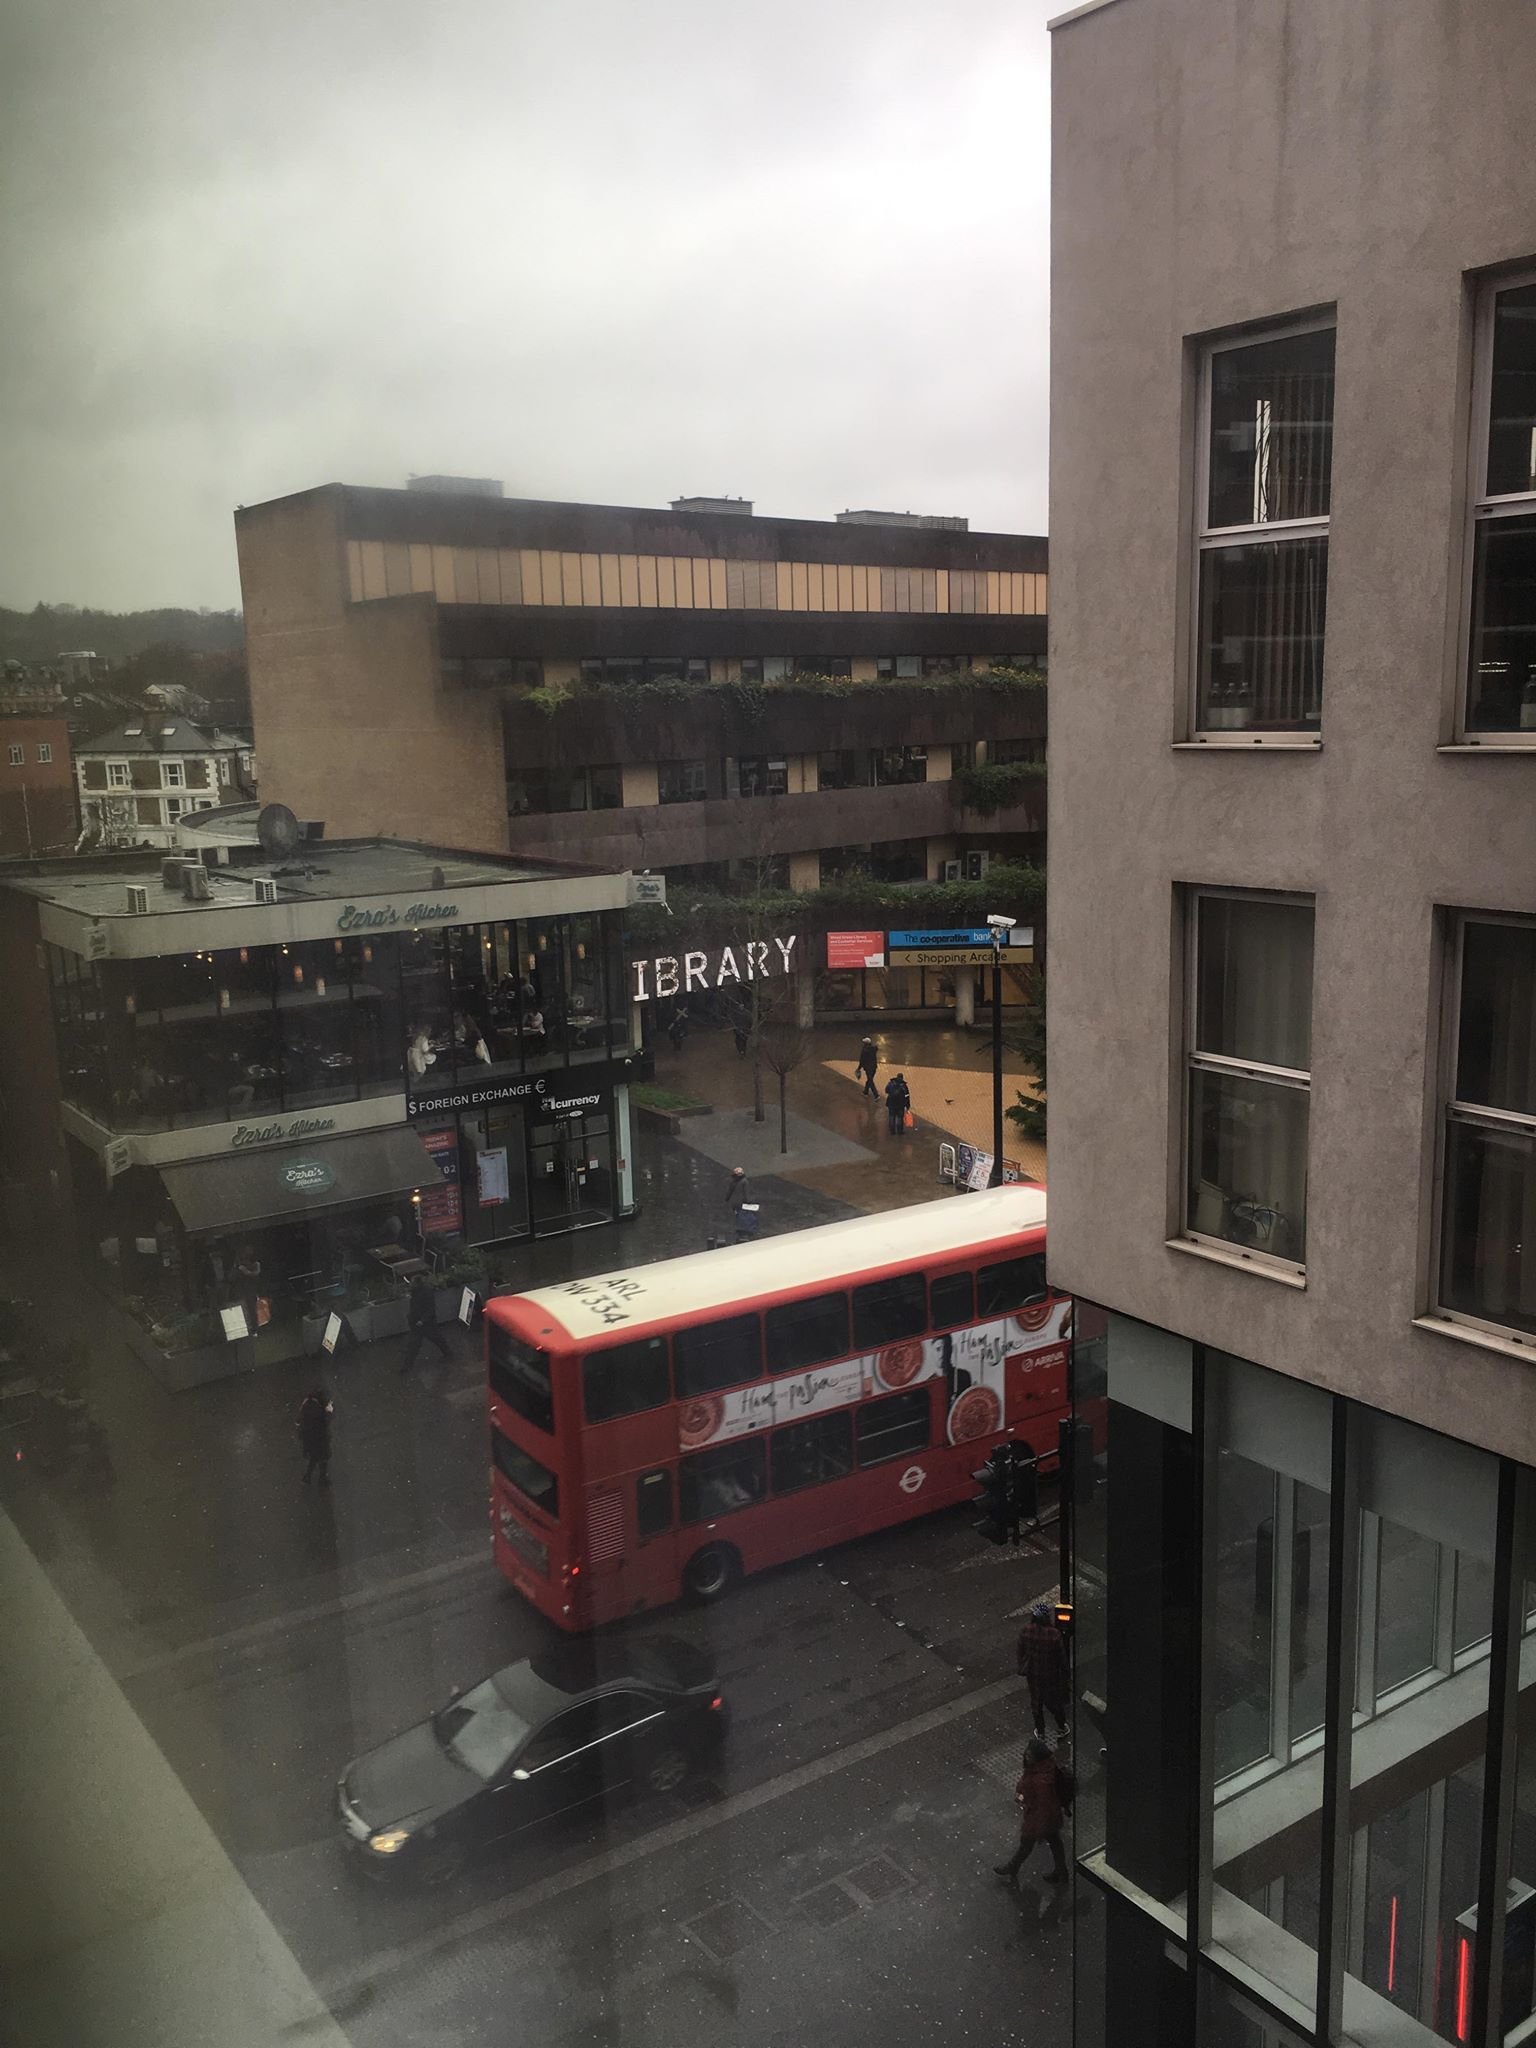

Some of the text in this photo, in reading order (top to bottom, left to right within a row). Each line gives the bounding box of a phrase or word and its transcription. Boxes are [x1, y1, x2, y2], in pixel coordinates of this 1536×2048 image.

[337, 903, 458, 930] Ezra's Kitchen
[904, 934, 918, 943] The
[920, 934, 969, 944] co-operative
[917, 952, 1007, 964] Shopping Arcae
[419, 1095, 469, 1112] FOREIGN
[472, 1084, 532, 1103] EXCHANGE
[231, 1123, 284, 1146] Ezra's
[286, 1167, 325, 1182] Ezra's
[599, 1278, 648, 1301] ARL
[581, 1294, 631, 1324] 334
